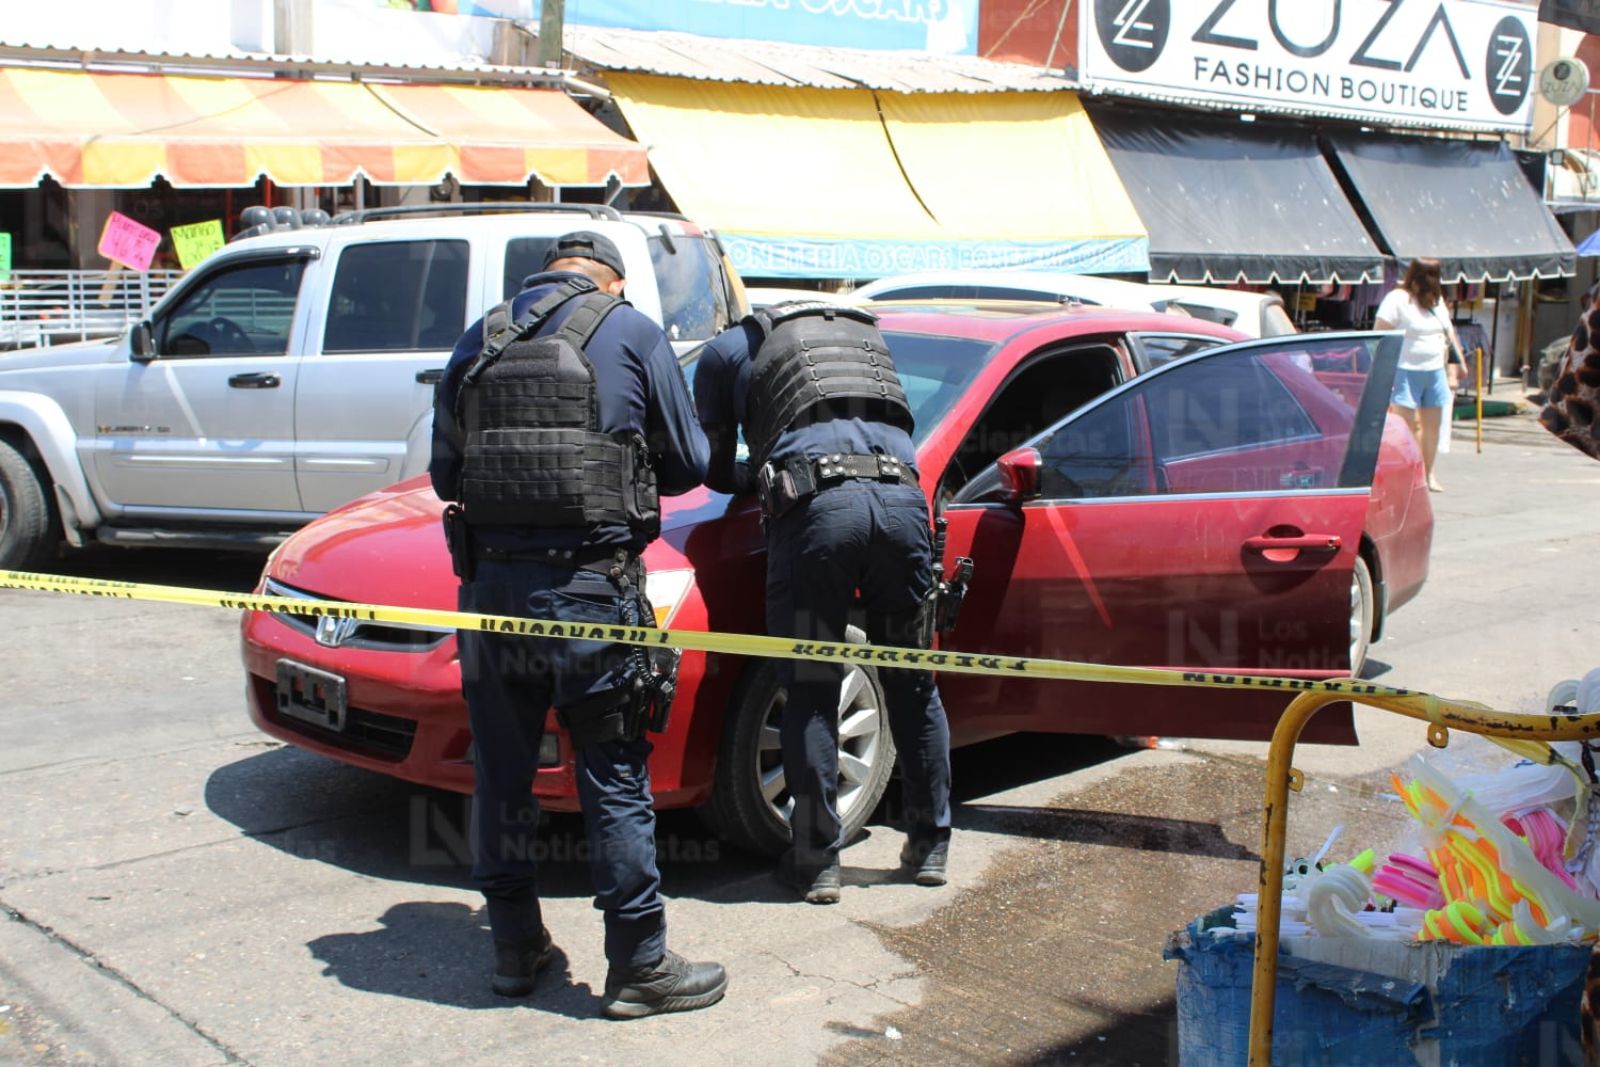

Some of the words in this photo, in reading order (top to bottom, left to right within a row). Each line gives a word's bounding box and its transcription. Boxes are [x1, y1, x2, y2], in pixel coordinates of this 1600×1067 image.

[1193, 56, 1330, 97] FASHION
[1340, 77, 1468, 111] BOUTIQUE
[728, 240, 859, 271] ONETERIA
[864, 244, 952, 274] OSCARS
